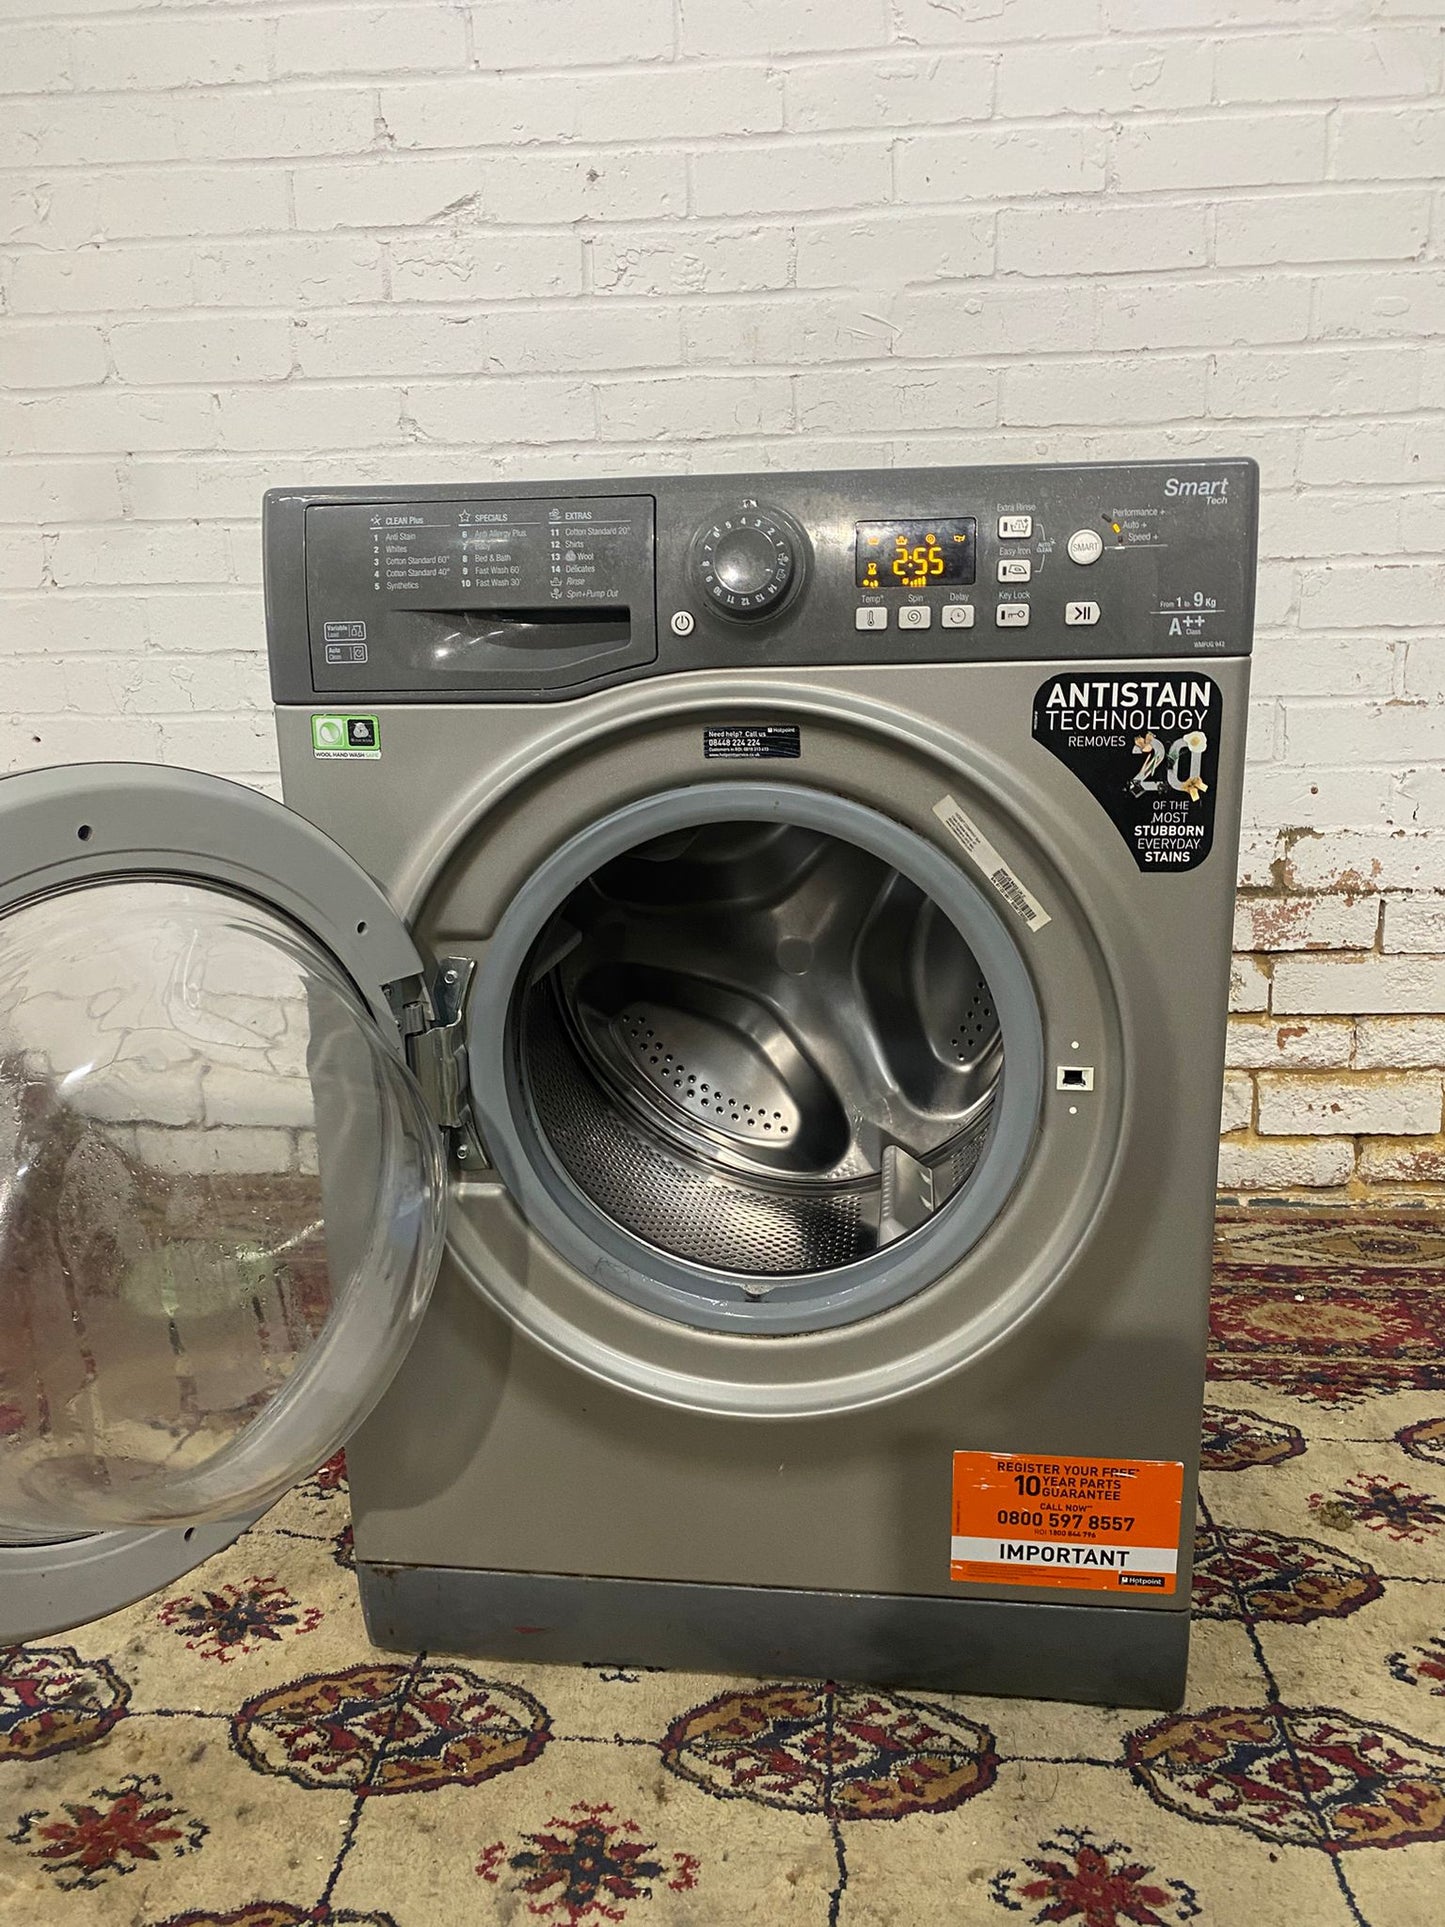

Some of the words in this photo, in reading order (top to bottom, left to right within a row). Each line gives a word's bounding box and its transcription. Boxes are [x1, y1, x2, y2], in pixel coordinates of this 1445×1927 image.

[1164, 478, 1228, 496] Smart
[1206, 496, 1227, 505] Tech
[997, 503, 1014, 512] Extra
[1016, 503, 1036, 511] Rinse
[1112, 508, 1157, 517] Performance
[386, 516, 408, 525] CLEAN
[410, 516, 424, 524] Plus
[475, 513, 508, 522] SPECIALS
[565, 512, 592, 520] EXTRAS
[1122, 521, 1139, 529] Auto
[550, 528, 559, 536] 11
[565, 528, 586, 536] Cotton
[588, 527, 616, 536] Standard
[1128, 532, 1150, 542] Speed
[999, 547, 1015, 556] Easy
[1017, 547, 1031, 555] Iron
[1072, 542, 1098, 552] SMART
[374, 558, 379, 566] 3
[386, 557, 407, 565] Cotton
[408, 556, 436, 565] Standard
[577, 553, 594, 561] Wool
[892, 547, 944, 575] 2:55
[374, 570, 379, 578] 4
[386, 569, 407, 577] Cotton
[408, 568, 436, 576] Standard
[462, 567, 468, 575] 9
[491, 566, 509, 574] Wash
[551, 565, 560, 573] 14
[566, 565, 595, 573] Delicates
[374, 582, 380, 590] 5
[908, 594, 924, 603] Spin
[950, 593, 969, 602] Delay
[998, 590, 1011, 600] Key
[1014, 590, 1031, 599] Lock
[1177, 597, 1181, 607] 1
[1194, 591, 1203, 607] 9
[1205, 598, 1216, 608] Kg
[1169, 616, 1205, 635] A++
[1046, 682, 1211, 708] ANTISTAIN
[1046, 709, 1208, 730] TECHNOLOGY
[1068, 735, 1126, 747] REMOVES
[1131, 733, 1207, 796] 20
[1153, 801, 1166, 810] OF
[1169, 800, 1189, 810] THE
[1153, 812, 1188, 823] MOST
[1134, 825, 1204, 836] STUBBORN
[1138, 838, 1200, 849] EVERYDAY
[1145, 852, 1190, 862] STAINS
[997, 1461, 1060, 1475] REGISTER
[1064, 1465, 1098, 1476] YOUR
[1014, 1475, 1041, 1496] 10
[1043, 1476, 1076, 1487] YEAR
[1080, 1478, 1121, 1490] PARTS
[1042, 1488, 1121, 1500] GUARANTEE
[1040, 1502, 1063, 1512] CALL
[998, 1510, 1042, 1526] 0800
[1049, 1514, 1083, 1529] 597
[1089, 1517, 1135, 1532] 8557
[1000, 1543, 1129, 1567] IMPORTANT
[1129, 1577, 1162, 1586] Hotpoint
